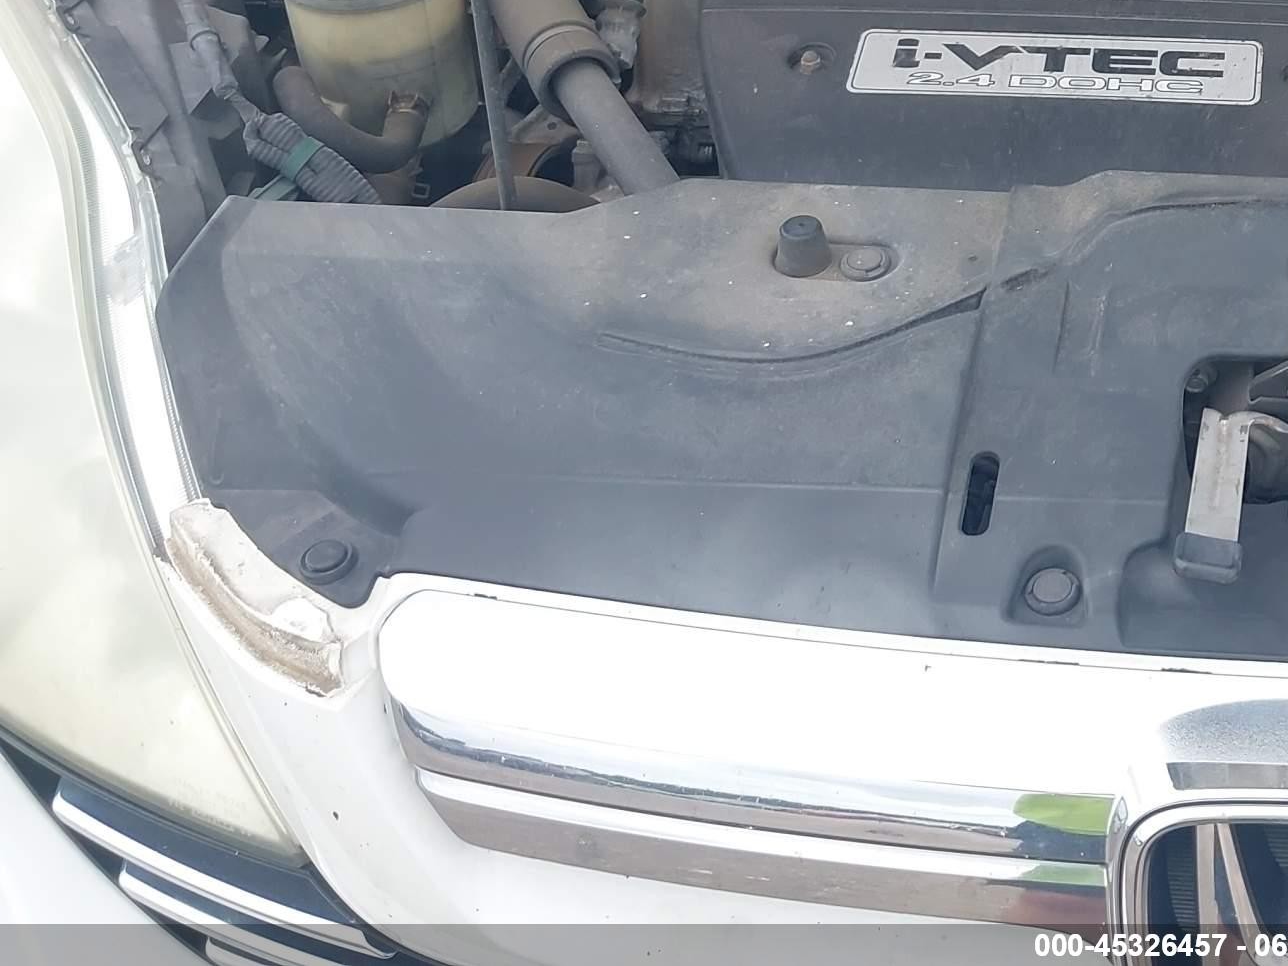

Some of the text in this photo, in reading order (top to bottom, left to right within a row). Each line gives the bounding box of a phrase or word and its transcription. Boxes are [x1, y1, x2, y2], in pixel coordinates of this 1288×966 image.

[892, 37, 1227, 78] i-VTEC
[906, 71, 1204, 95] 2.4 DOHC
